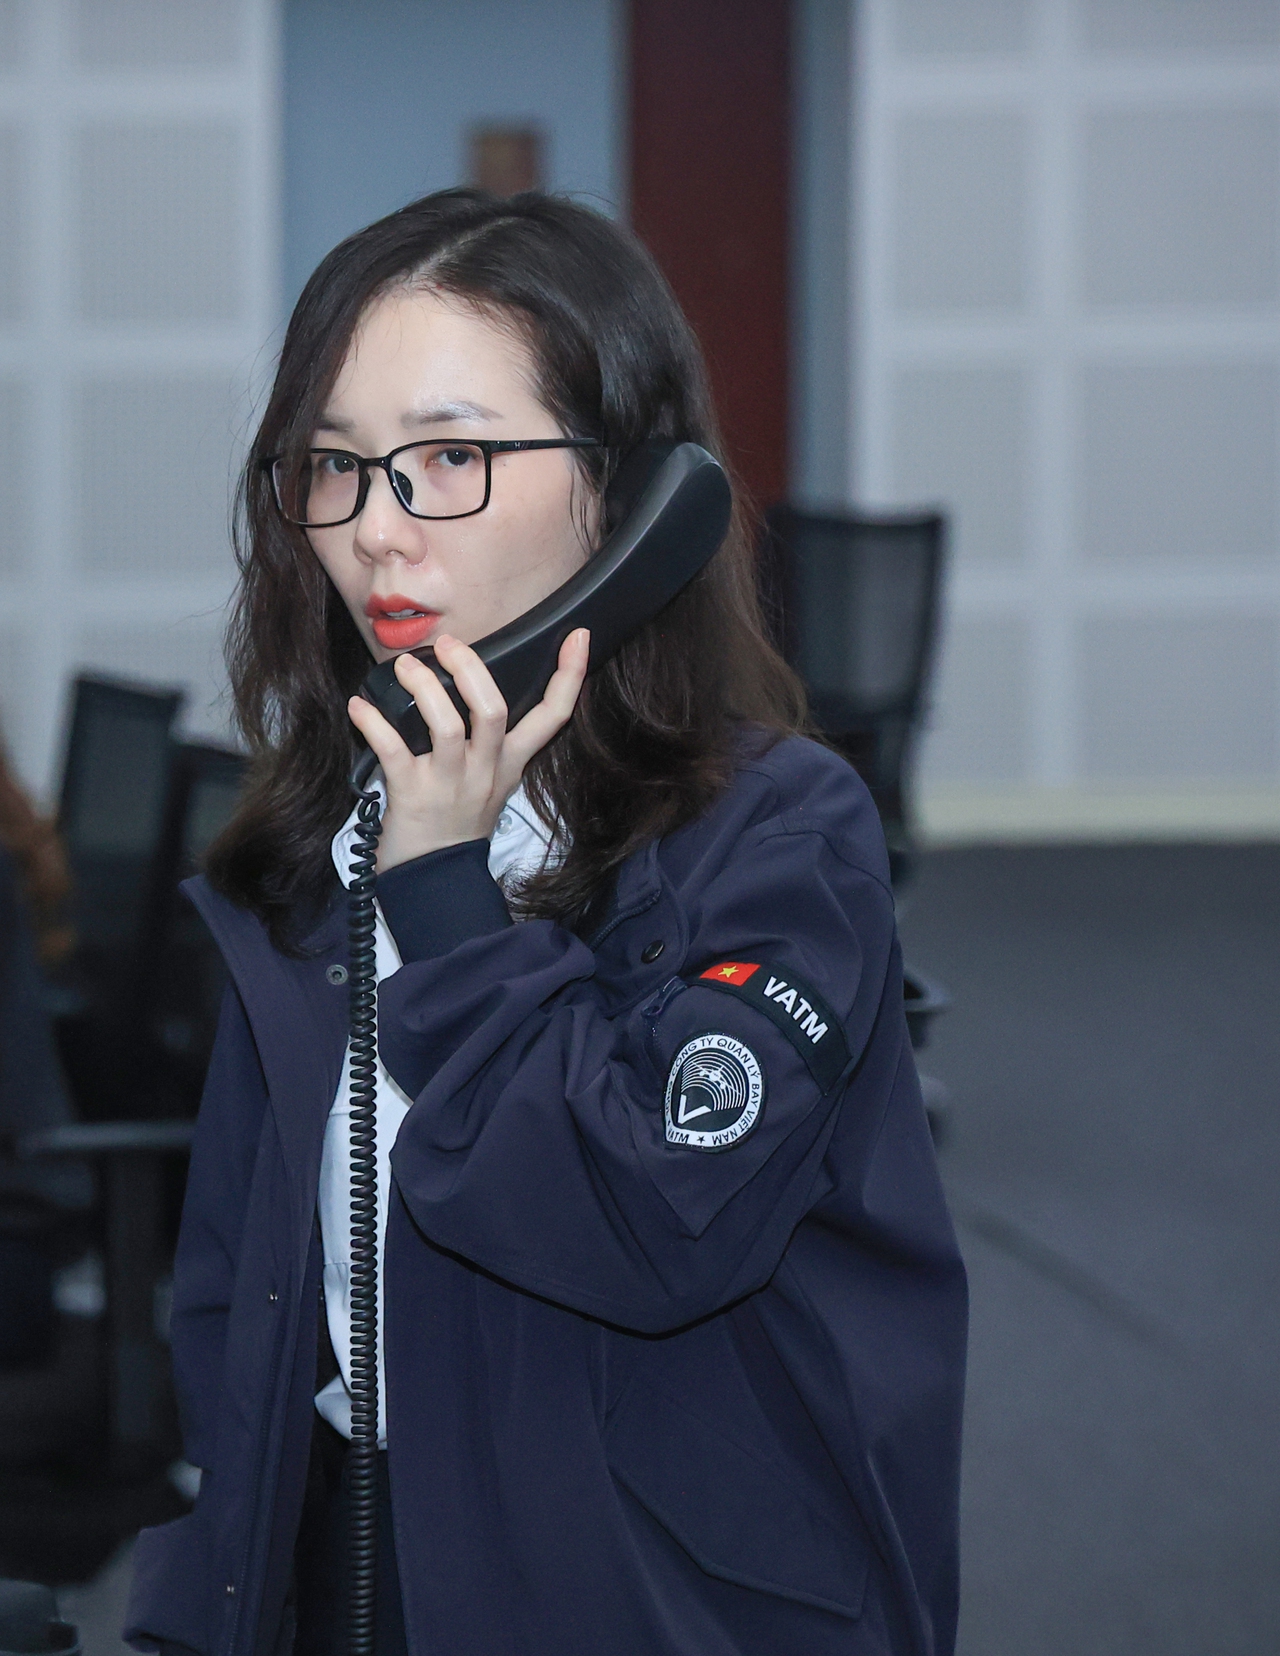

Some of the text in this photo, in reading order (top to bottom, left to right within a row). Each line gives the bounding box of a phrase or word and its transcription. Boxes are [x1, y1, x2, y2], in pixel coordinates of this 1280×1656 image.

[763, 976, 829, 1045] VATM
[700, 1037, 714, 1047] TY
[751, 1083, 760, 1108] BAY
[712, 1128, 738, 1146] NAM
